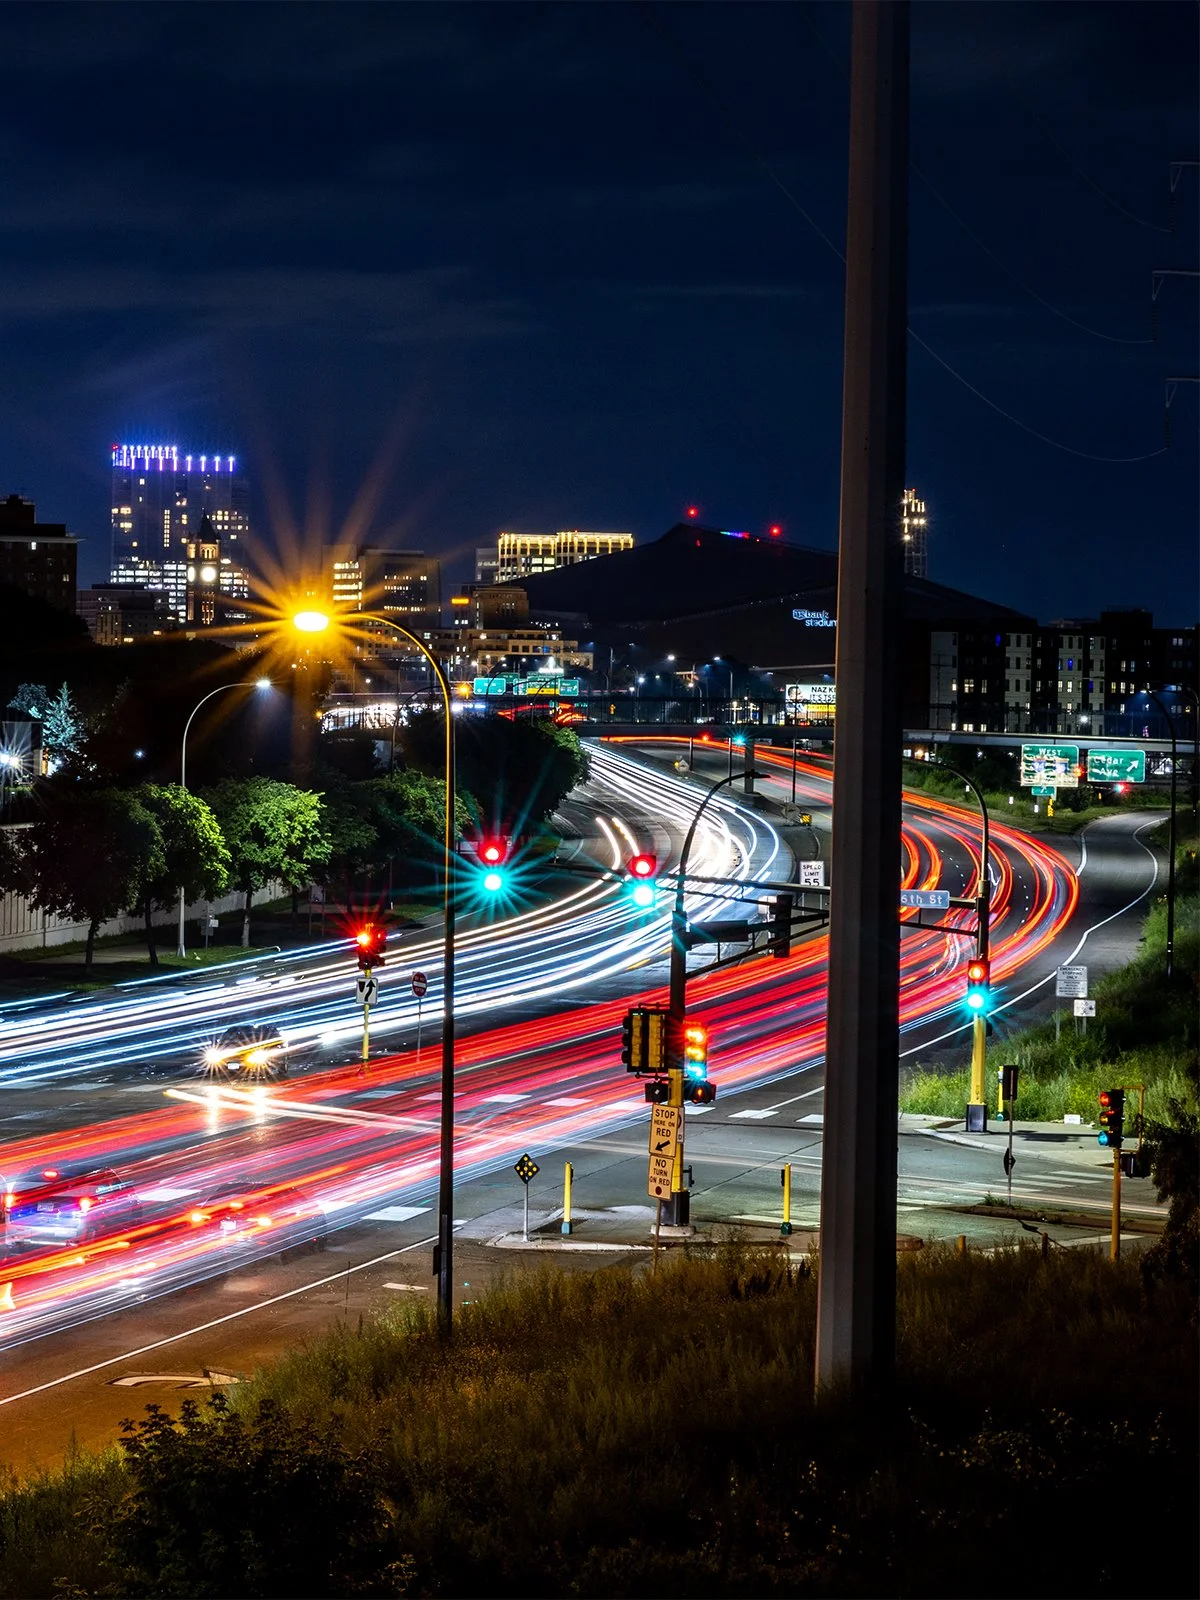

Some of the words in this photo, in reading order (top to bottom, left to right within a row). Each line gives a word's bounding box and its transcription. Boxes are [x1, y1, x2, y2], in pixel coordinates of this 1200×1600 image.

[805, 618, 838, 627] stadium
[1038, 747, 1062, 756] WEST
[1094, 755, 1124, 765] Cedar
[1099, 768, 1120, 777] Ave
[804, 878, 820, 886] 55
[929, 894, 942, 904] St
[655, 1108, 675, 1119] STOP
[654, 1119, 666, 1127] HERE
[667, 1120, 675, 1128] ON
[656, 1127, 671, 1138] RED
[655, 1158, 667, 1168] NO
[653, 1168, 668, 1177] TURN
[649, 1175, 658, 1183] ON
[658, 1177, 670, 1186] RED
